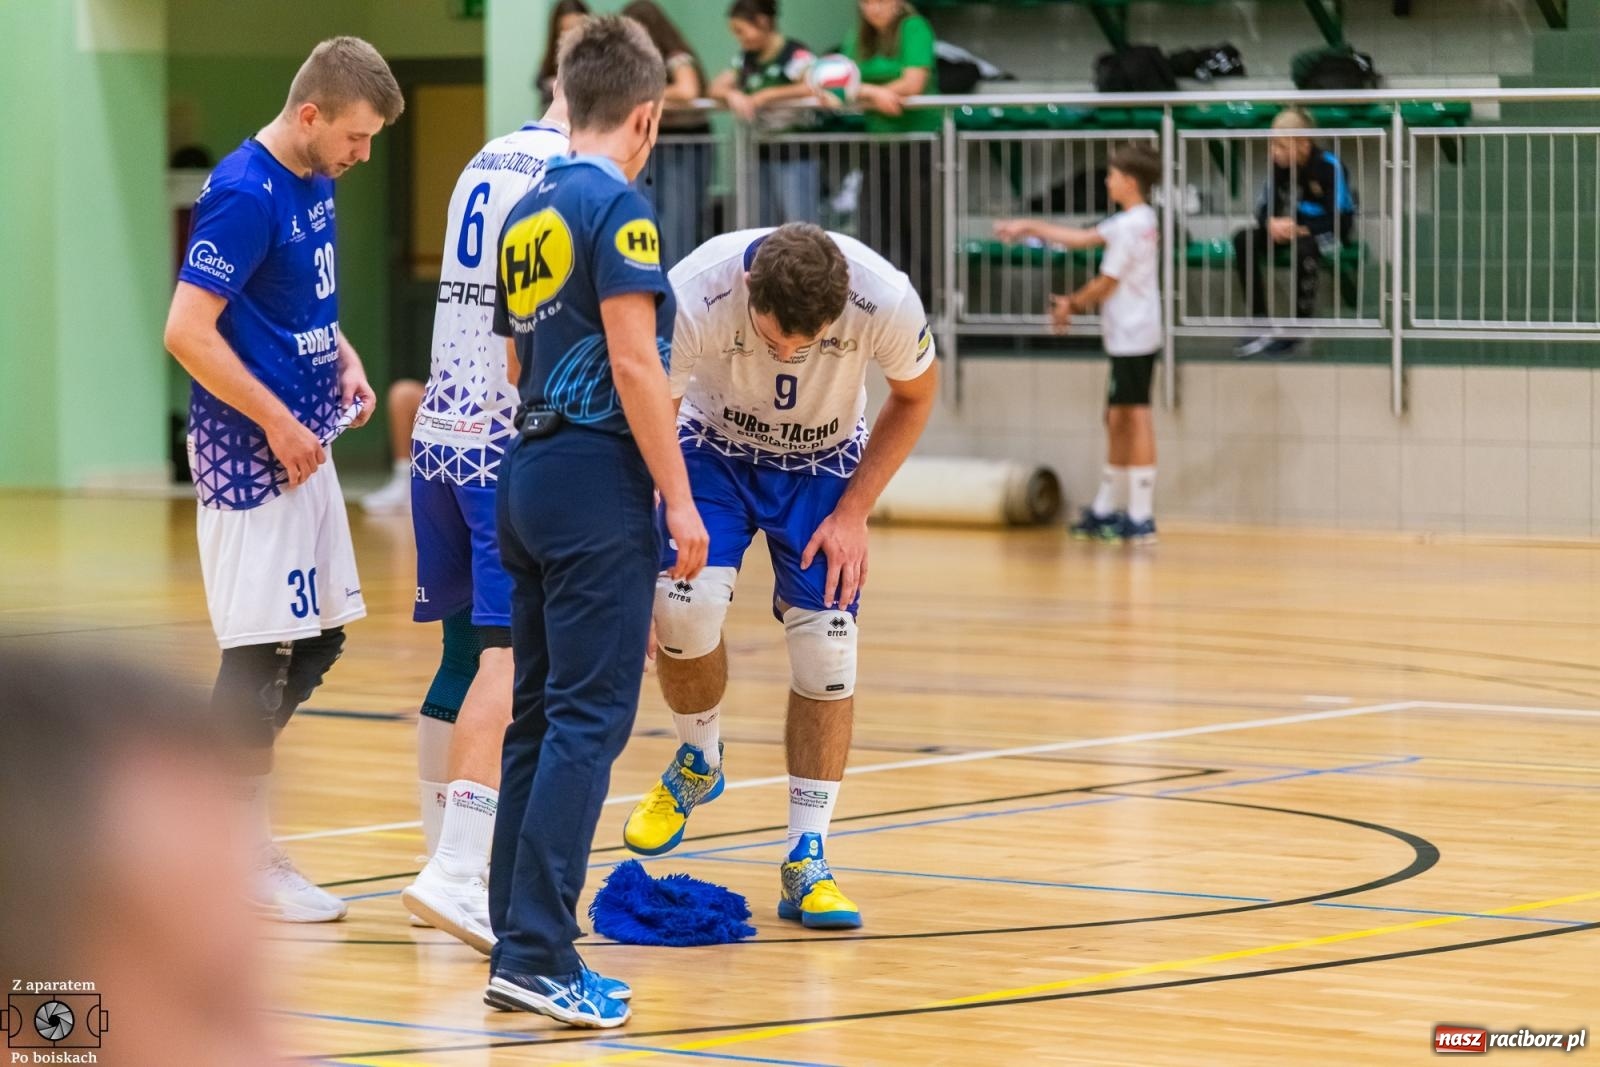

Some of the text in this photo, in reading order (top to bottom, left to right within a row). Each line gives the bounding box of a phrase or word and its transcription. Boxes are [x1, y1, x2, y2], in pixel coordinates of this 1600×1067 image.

[457, 182, 491, 268] 6
[197, 249, 235, 274] Carbo
[314, 242, 336, 299] 30
[505, 230, 553, 296] HK
[774, 373, 798, 411] 9
[723, 405, 839, 443] EURO-TACHO
[737, 430, 824, 450] eurotacho.pl
[668, 591, 691, 603] errea
[827, 629, 847, 637] errea
